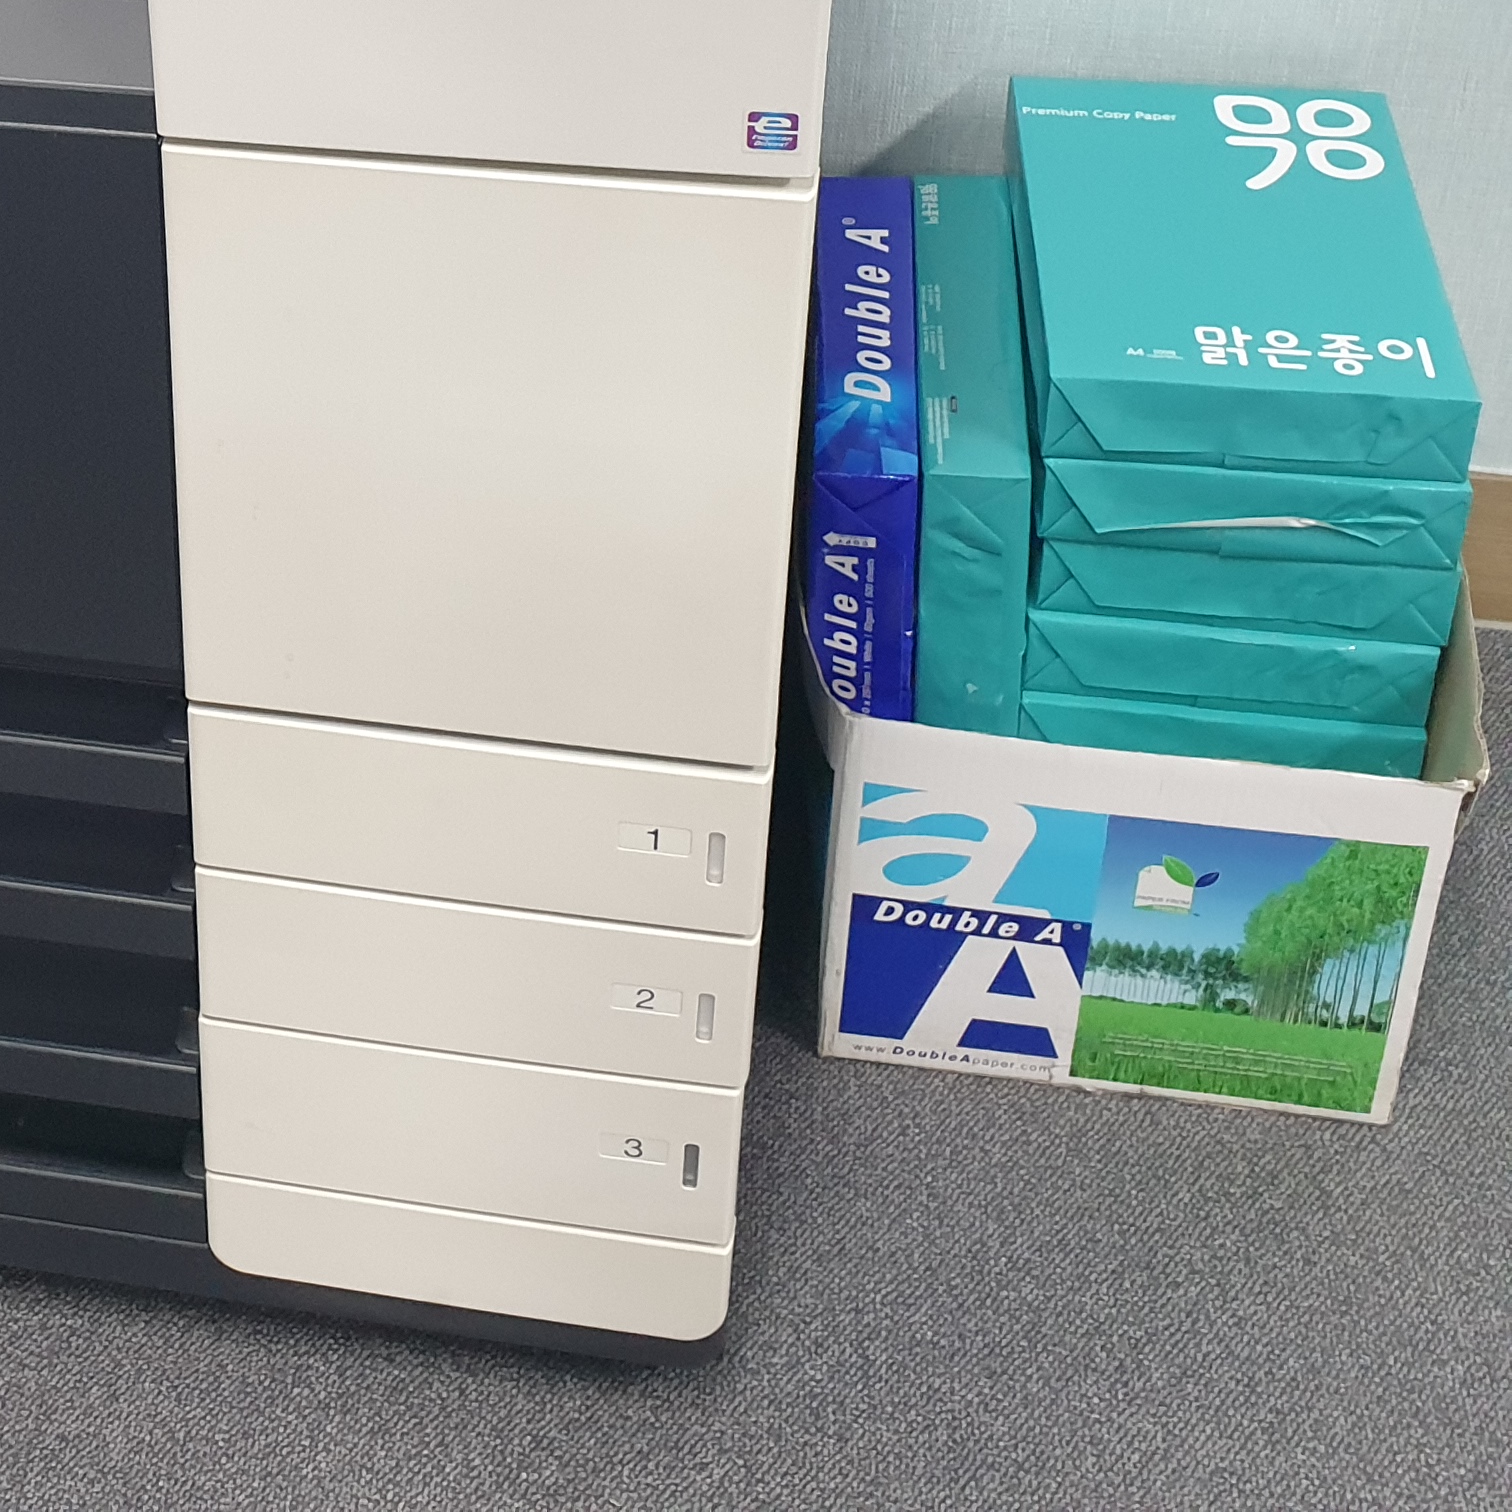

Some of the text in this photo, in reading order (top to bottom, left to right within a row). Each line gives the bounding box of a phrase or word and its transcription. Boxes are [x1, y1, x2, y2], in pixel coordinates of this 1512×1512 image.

[1022, 106, 1176, 122] Premium Copy Paper
[1213, 94, 1386, 191] 98
[843, 264, 892, 403] Double
[1193, 325, 1436, 379] 맑은종이
[825, 554, 859, 582] A
[823, 593, 859, 701] ouble
[646, 828, 659, 851] 1
[873, 900, 1063, 944] Double A
[635, 989, 655, 1010] 2
[623, 1138, 644, 1159] 3
